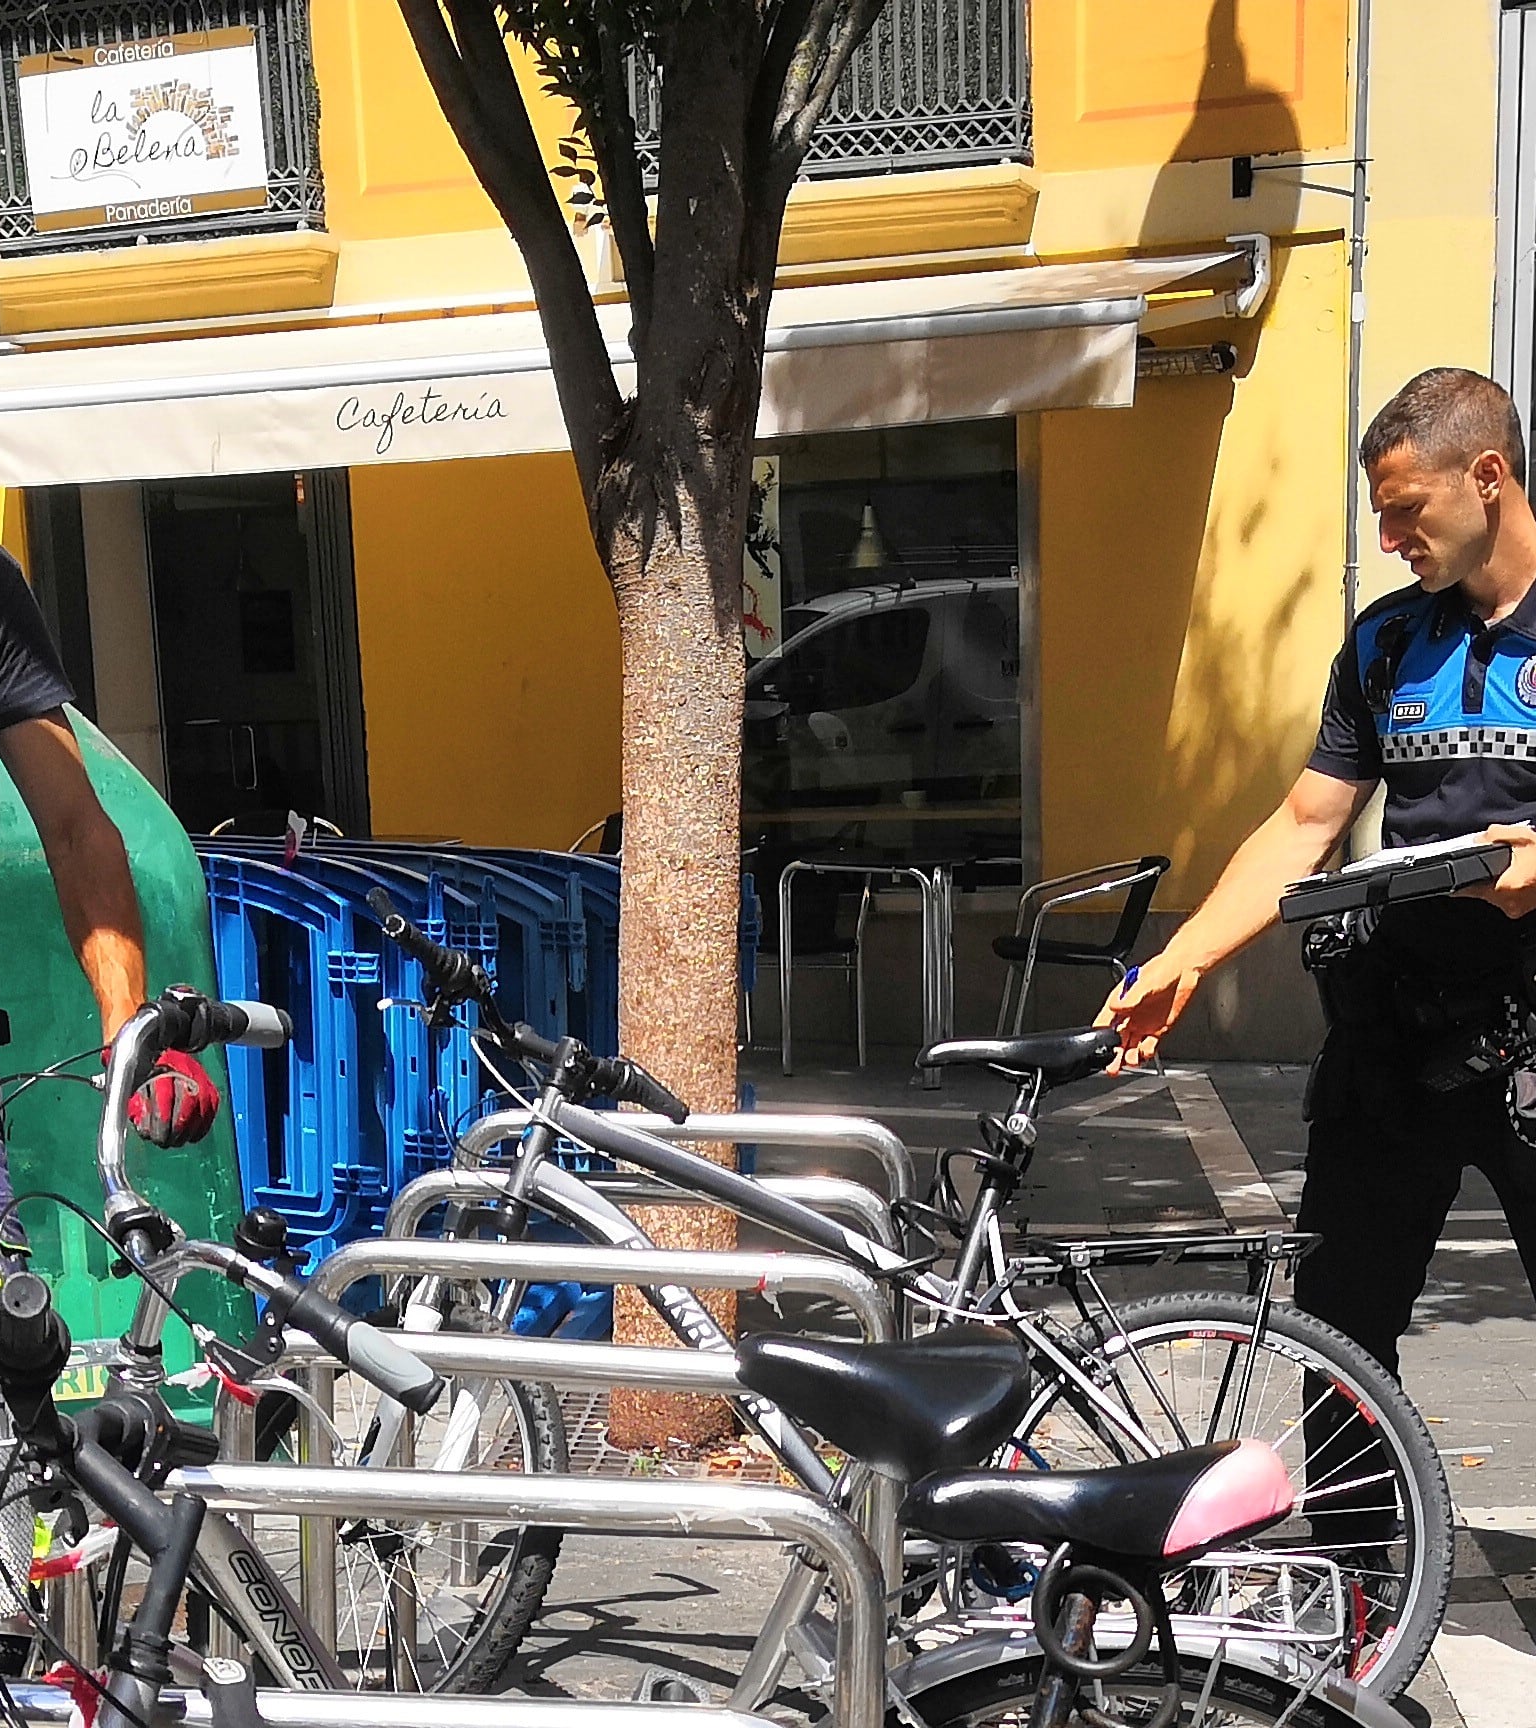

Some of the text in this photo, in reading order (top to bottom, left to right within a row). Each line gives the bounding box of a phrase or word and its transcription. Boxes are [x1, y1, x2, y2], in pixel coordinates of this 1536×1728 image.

[94, 39, 175, 67] Cafetería
[91, 90, 125, 124] la
[104, 197, 193, 223] Panadería
[336, 386, 509, 455] Cafetería
